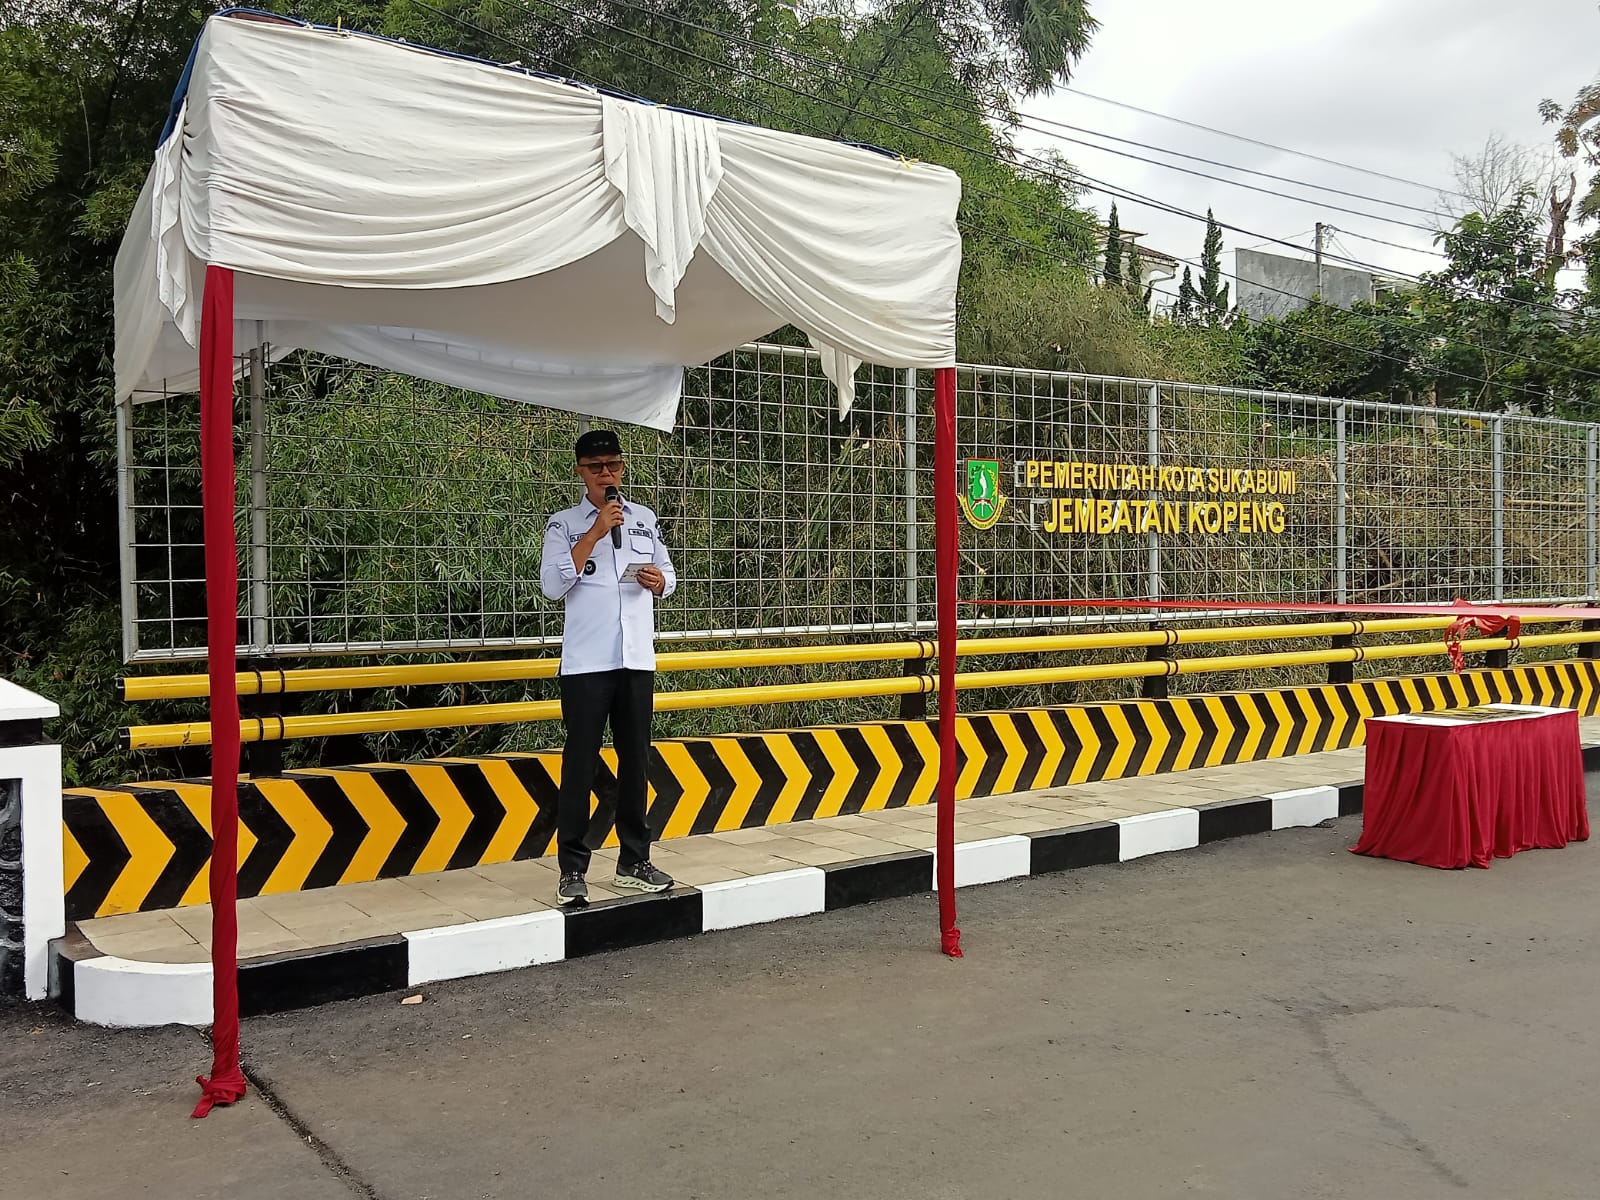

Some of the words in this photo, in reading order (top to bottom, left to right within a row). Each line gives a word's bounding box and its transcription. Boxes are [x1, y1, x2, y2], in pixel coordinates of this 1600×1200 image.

[1026, 460, 1155, 491] PEMERINTAH
[1158, 465, 1206, 492] KOTA
[1207, 467, 1297, 495] SUKABUMI
[1043, 497, 1181, 534] JEMBATAN
[1187, 501, 1286, 534] KOPENG
